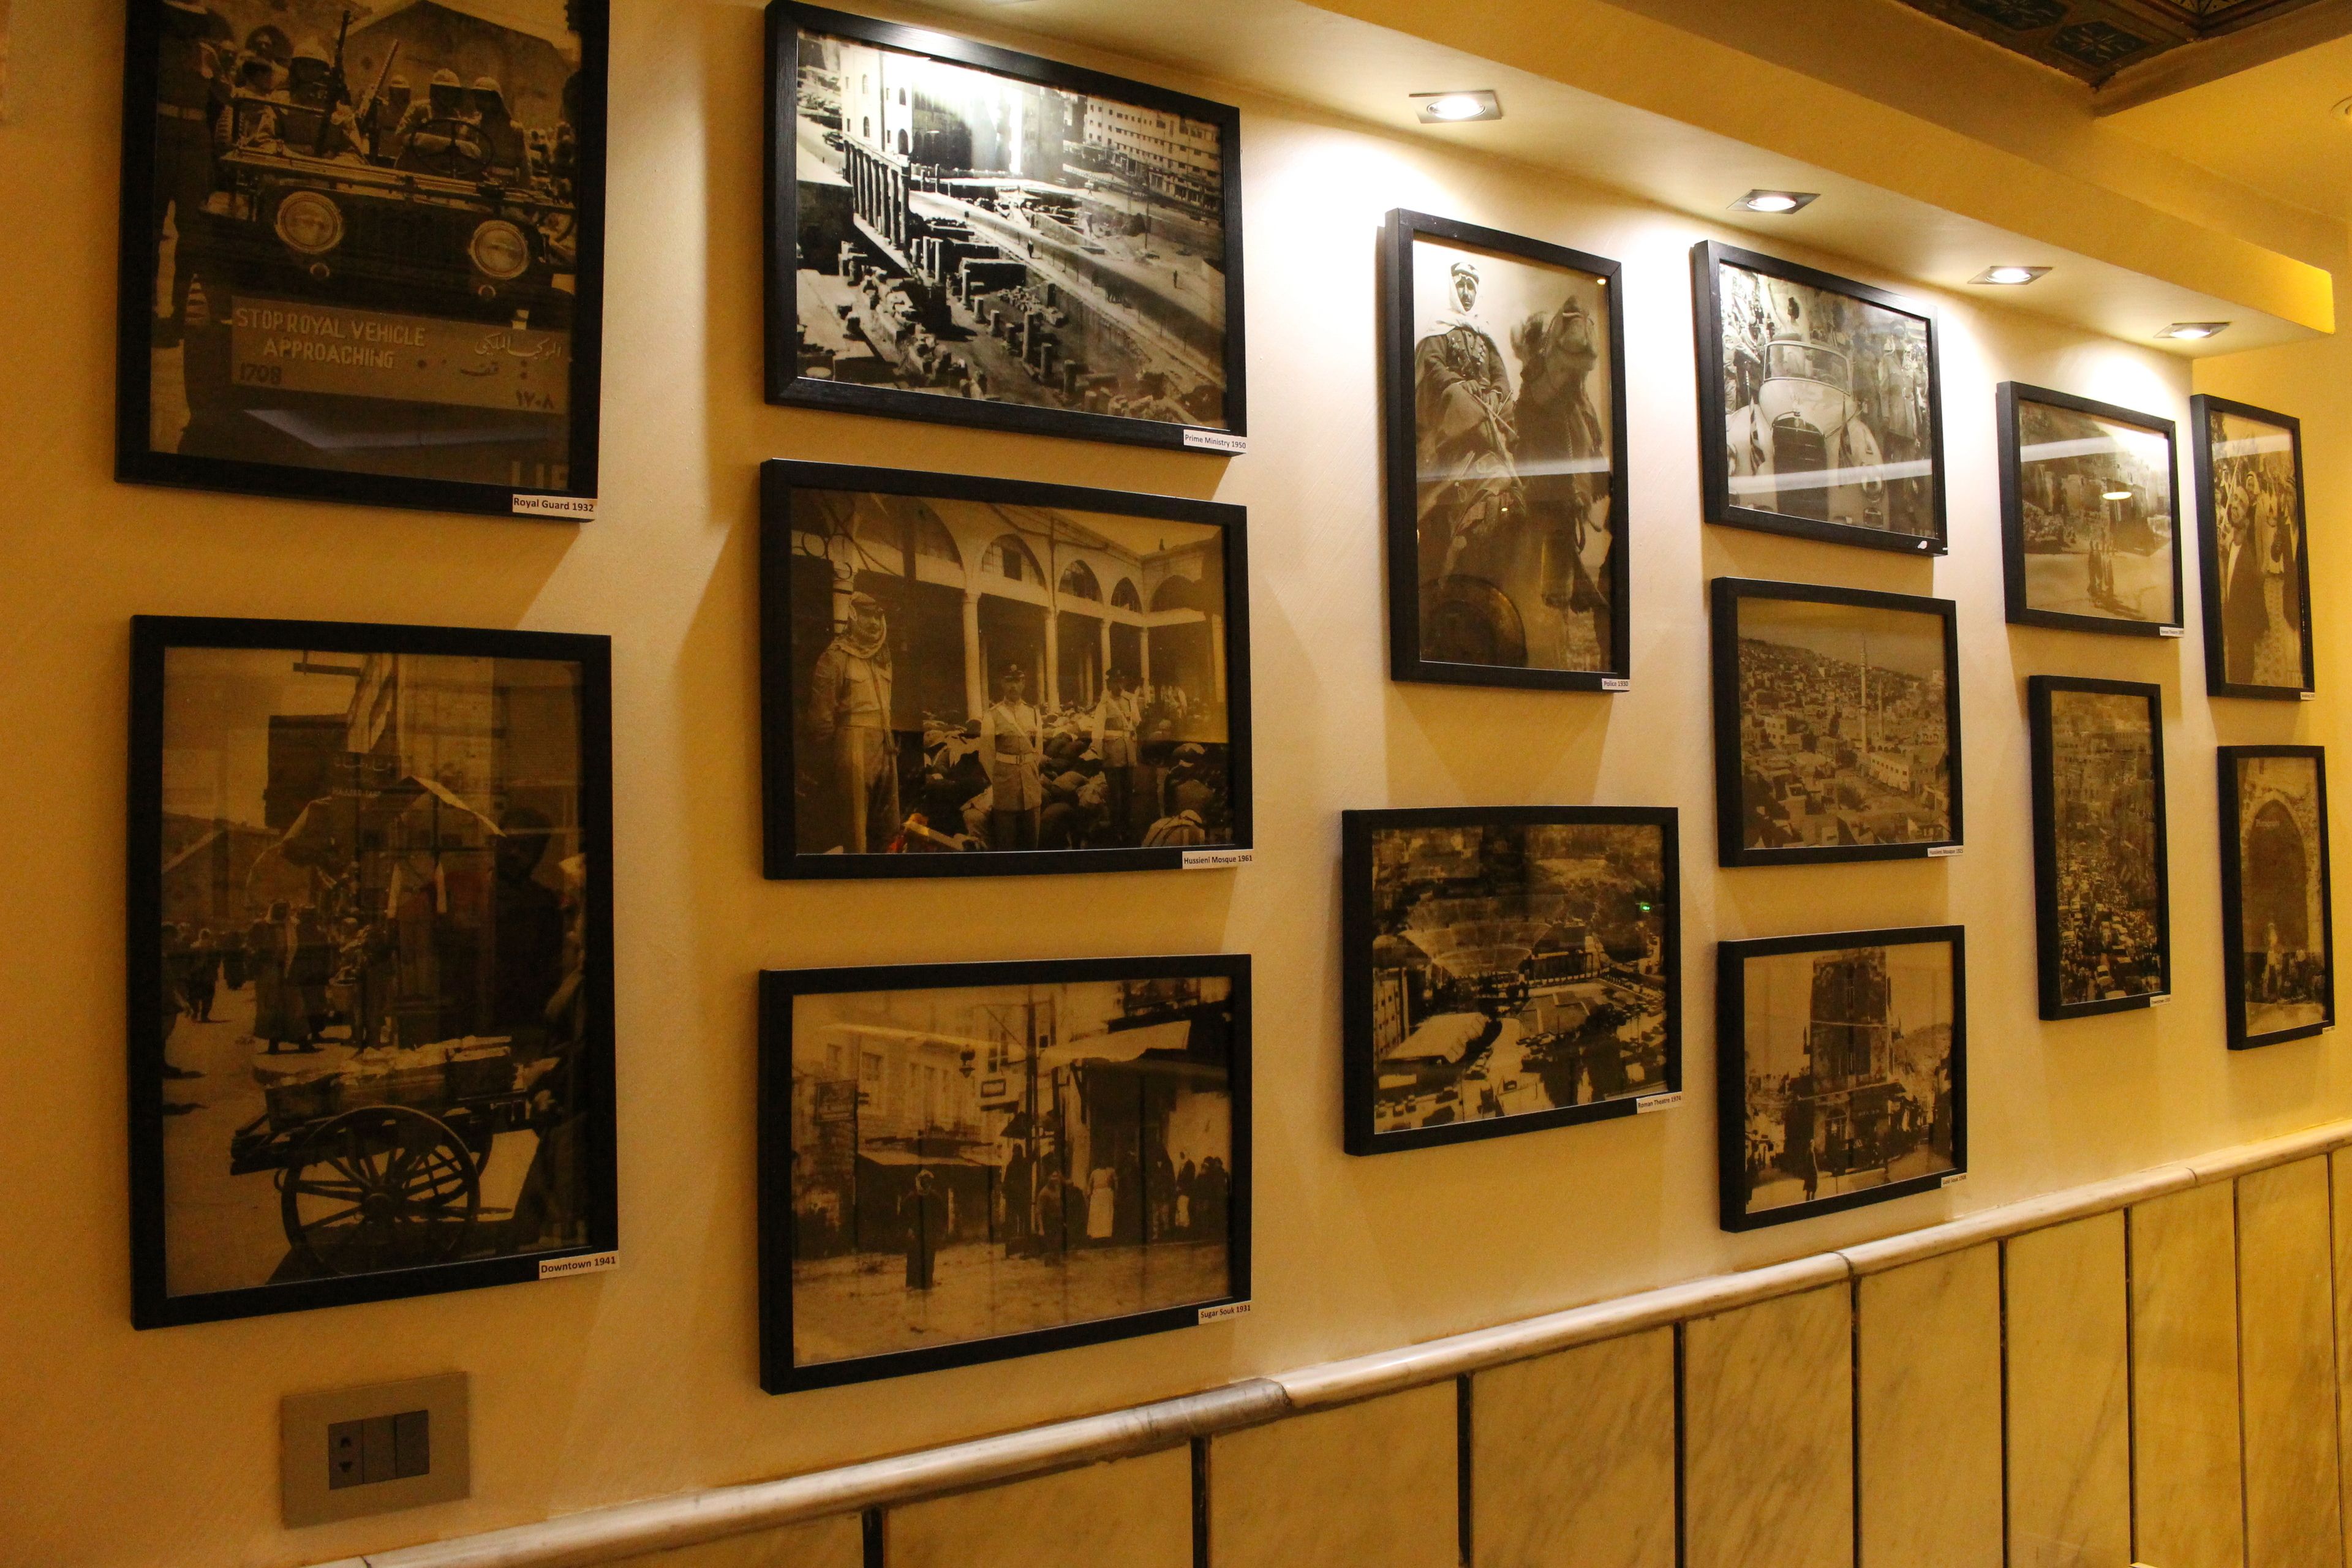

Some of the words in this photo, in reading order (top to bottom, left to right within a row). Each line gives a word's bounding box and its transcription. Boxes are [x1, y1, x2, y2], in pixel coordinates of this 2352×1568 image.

[236, 307, 284, 330] STOP
[287, 313, 345, 339] ROYAL
[351, 319, 426, 347] VEHICLE
[263, 337, 395, 369] APPROACHING
[1185, 434, 1204, 443] Prime
[1205, 437, 1230, 448] Ministry
[513, 497, 539, 508] Royal
[541, 500, 570, 510] Guard
[572, 503, 594, 512] 1932
[1184, 856, 1210, 865] Hussieni
[1212, 856, 1237, 864] Mosque
[541, 1261, 592, 1273] Downtown
[594, 1256, 616, 1267] 1941
[1200, 1310, 1218, 1319] Sugar
[1219, 1306, 1235, 1316] Souk
[1236, 1304, 1251, 1313] 1931
